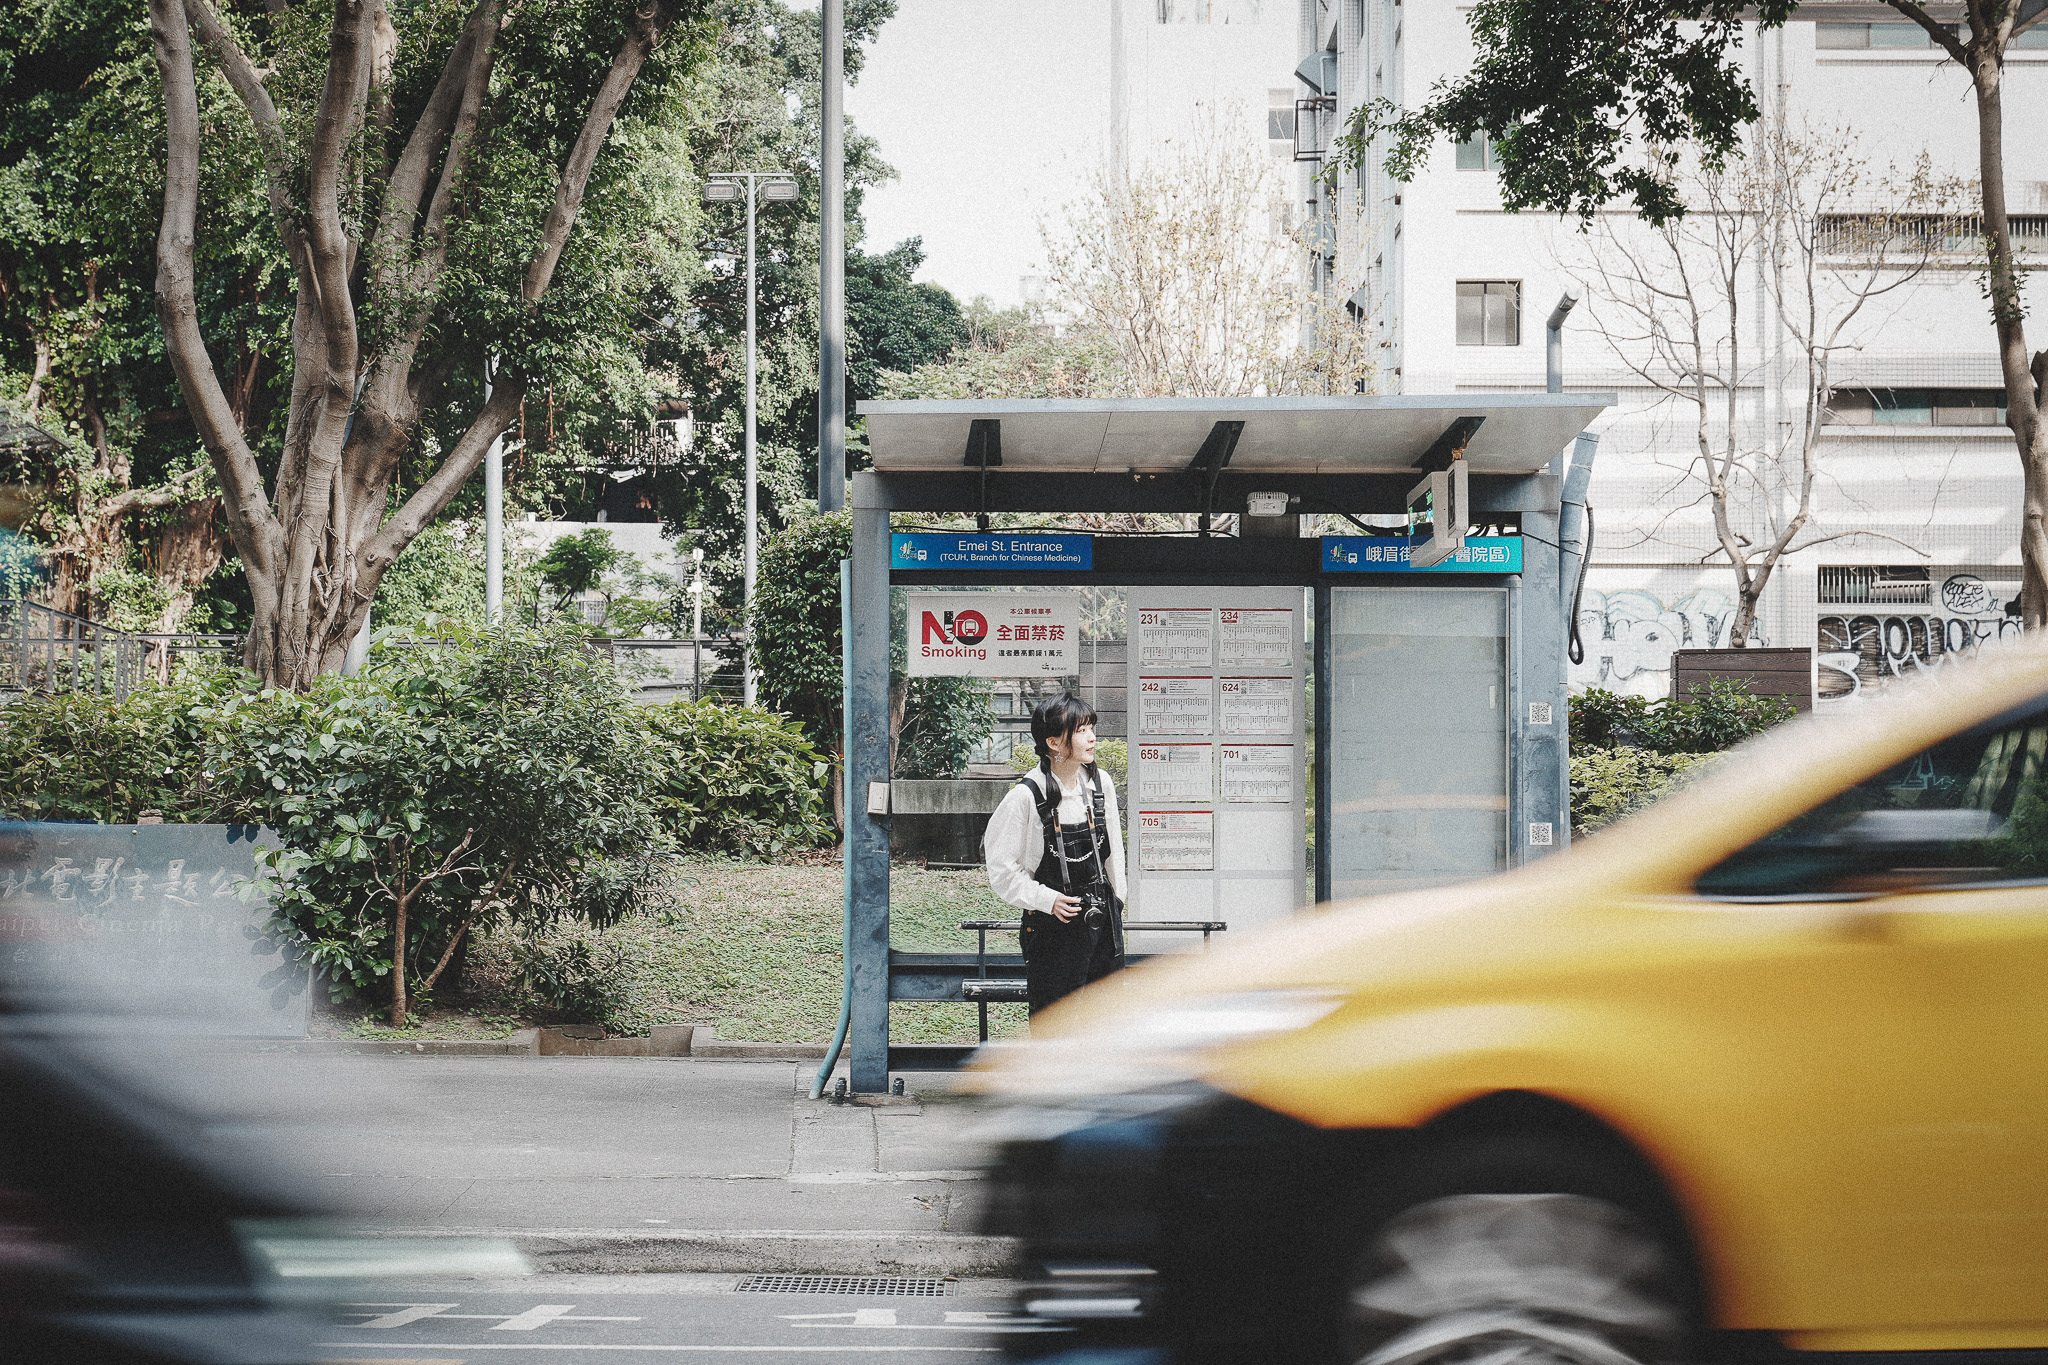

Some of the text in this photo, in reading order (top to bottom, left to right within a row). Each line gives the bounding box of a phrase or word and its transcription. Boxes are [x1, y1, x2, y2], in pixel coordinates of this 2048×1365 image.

[958, 540, 1063, 552] Emei St. Entrance
[940, 553, 1081, 562] (TCUH, Branch for Chinese Medicine)
[1140, 613, 1159, 625] 231
[1220, 611, 1239, 620] 234
[921, 609, 989, 646] NO
[996, 624, 1066, 641] 全面禁菸
[921, 645, 987, 660] Smoking
[1141, 682, 1159, 692] 242
[1222, 683, 1240, 692] 624
[1140, 749, 1159, 760] 658
[1223, 750, 1240, 759] 701
[1141, 817, 1159, 827] 705
